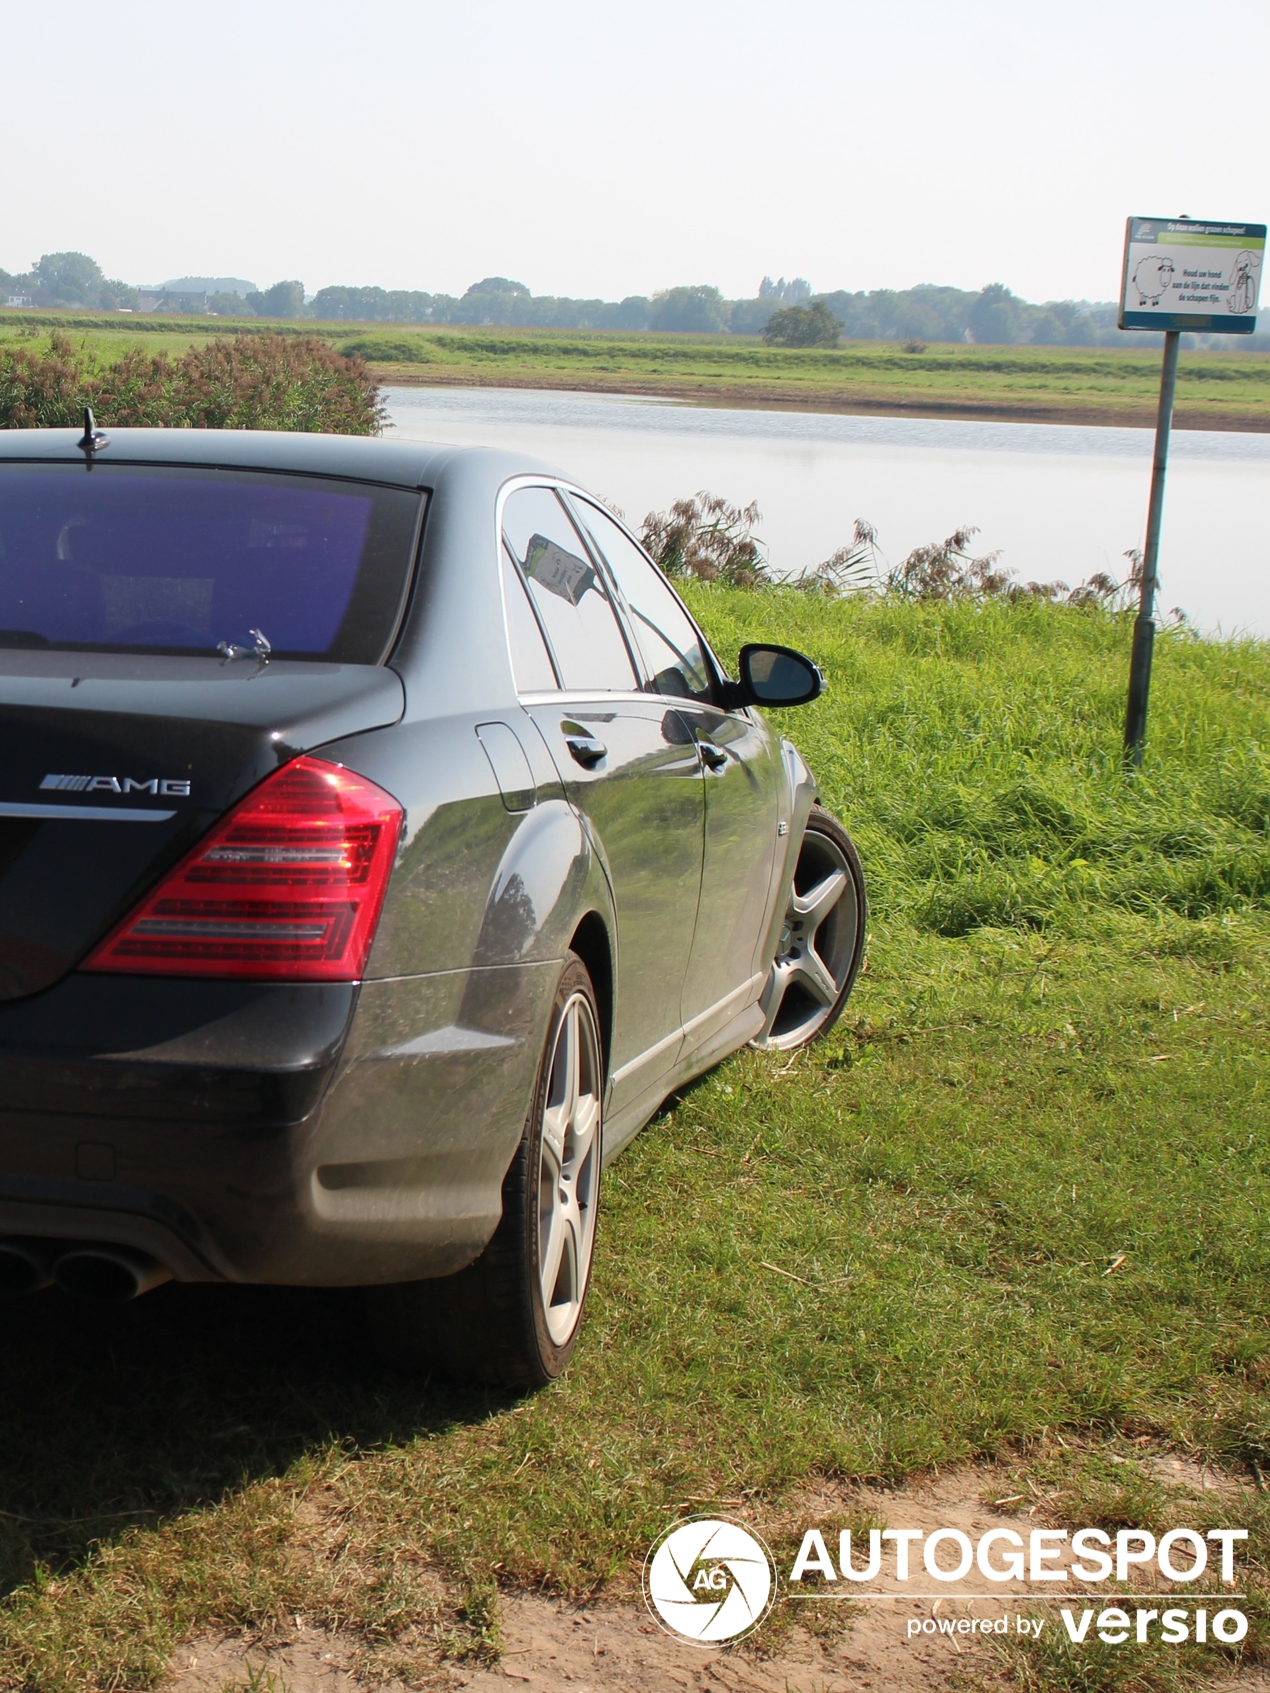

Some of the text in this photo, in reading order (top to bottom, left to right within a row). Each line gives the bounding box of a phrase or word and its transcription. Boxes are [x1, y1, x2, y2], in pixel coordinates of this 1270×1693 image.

[1183, 269, 1198, 278] Houd
[1208, 270, 1222, 279] hond
[1183, 280, 1191, 289] de
[1191, 281, 1201, 291] lijn
[1201, 281, 1210, 290] dat
[1211, 282, 1229, 291] vinden
[1179, 293, 1186, 301] de
[1186, 294, 1208, 304] schapen
[85, 775, 191, 797] AMG
